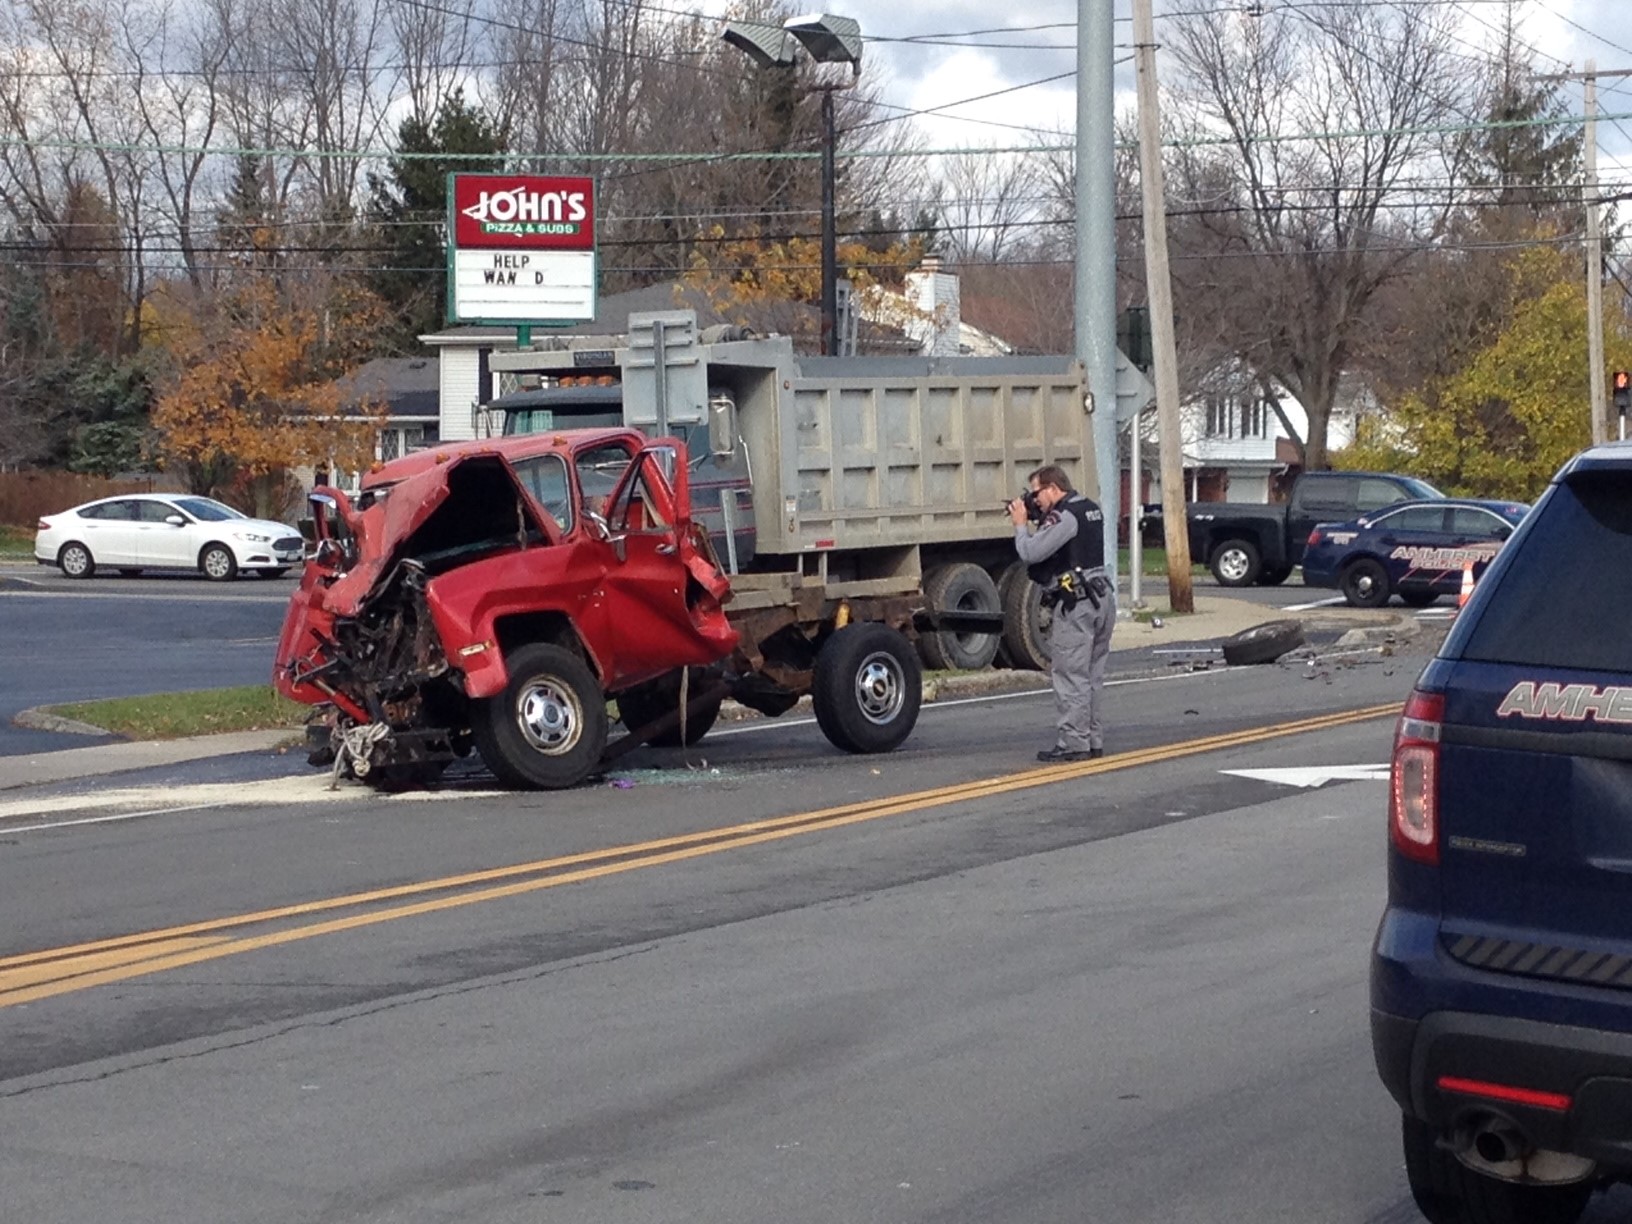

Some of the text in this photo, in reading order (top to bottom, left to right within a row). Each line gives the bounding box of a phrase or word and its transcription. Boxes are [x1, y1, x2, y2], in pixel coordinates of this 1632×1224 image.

[472, 190, 586, 221] JOHN'S
[493, 255, 530, 269] HELP
[1390, 545, 1496, 562] AMHERST
